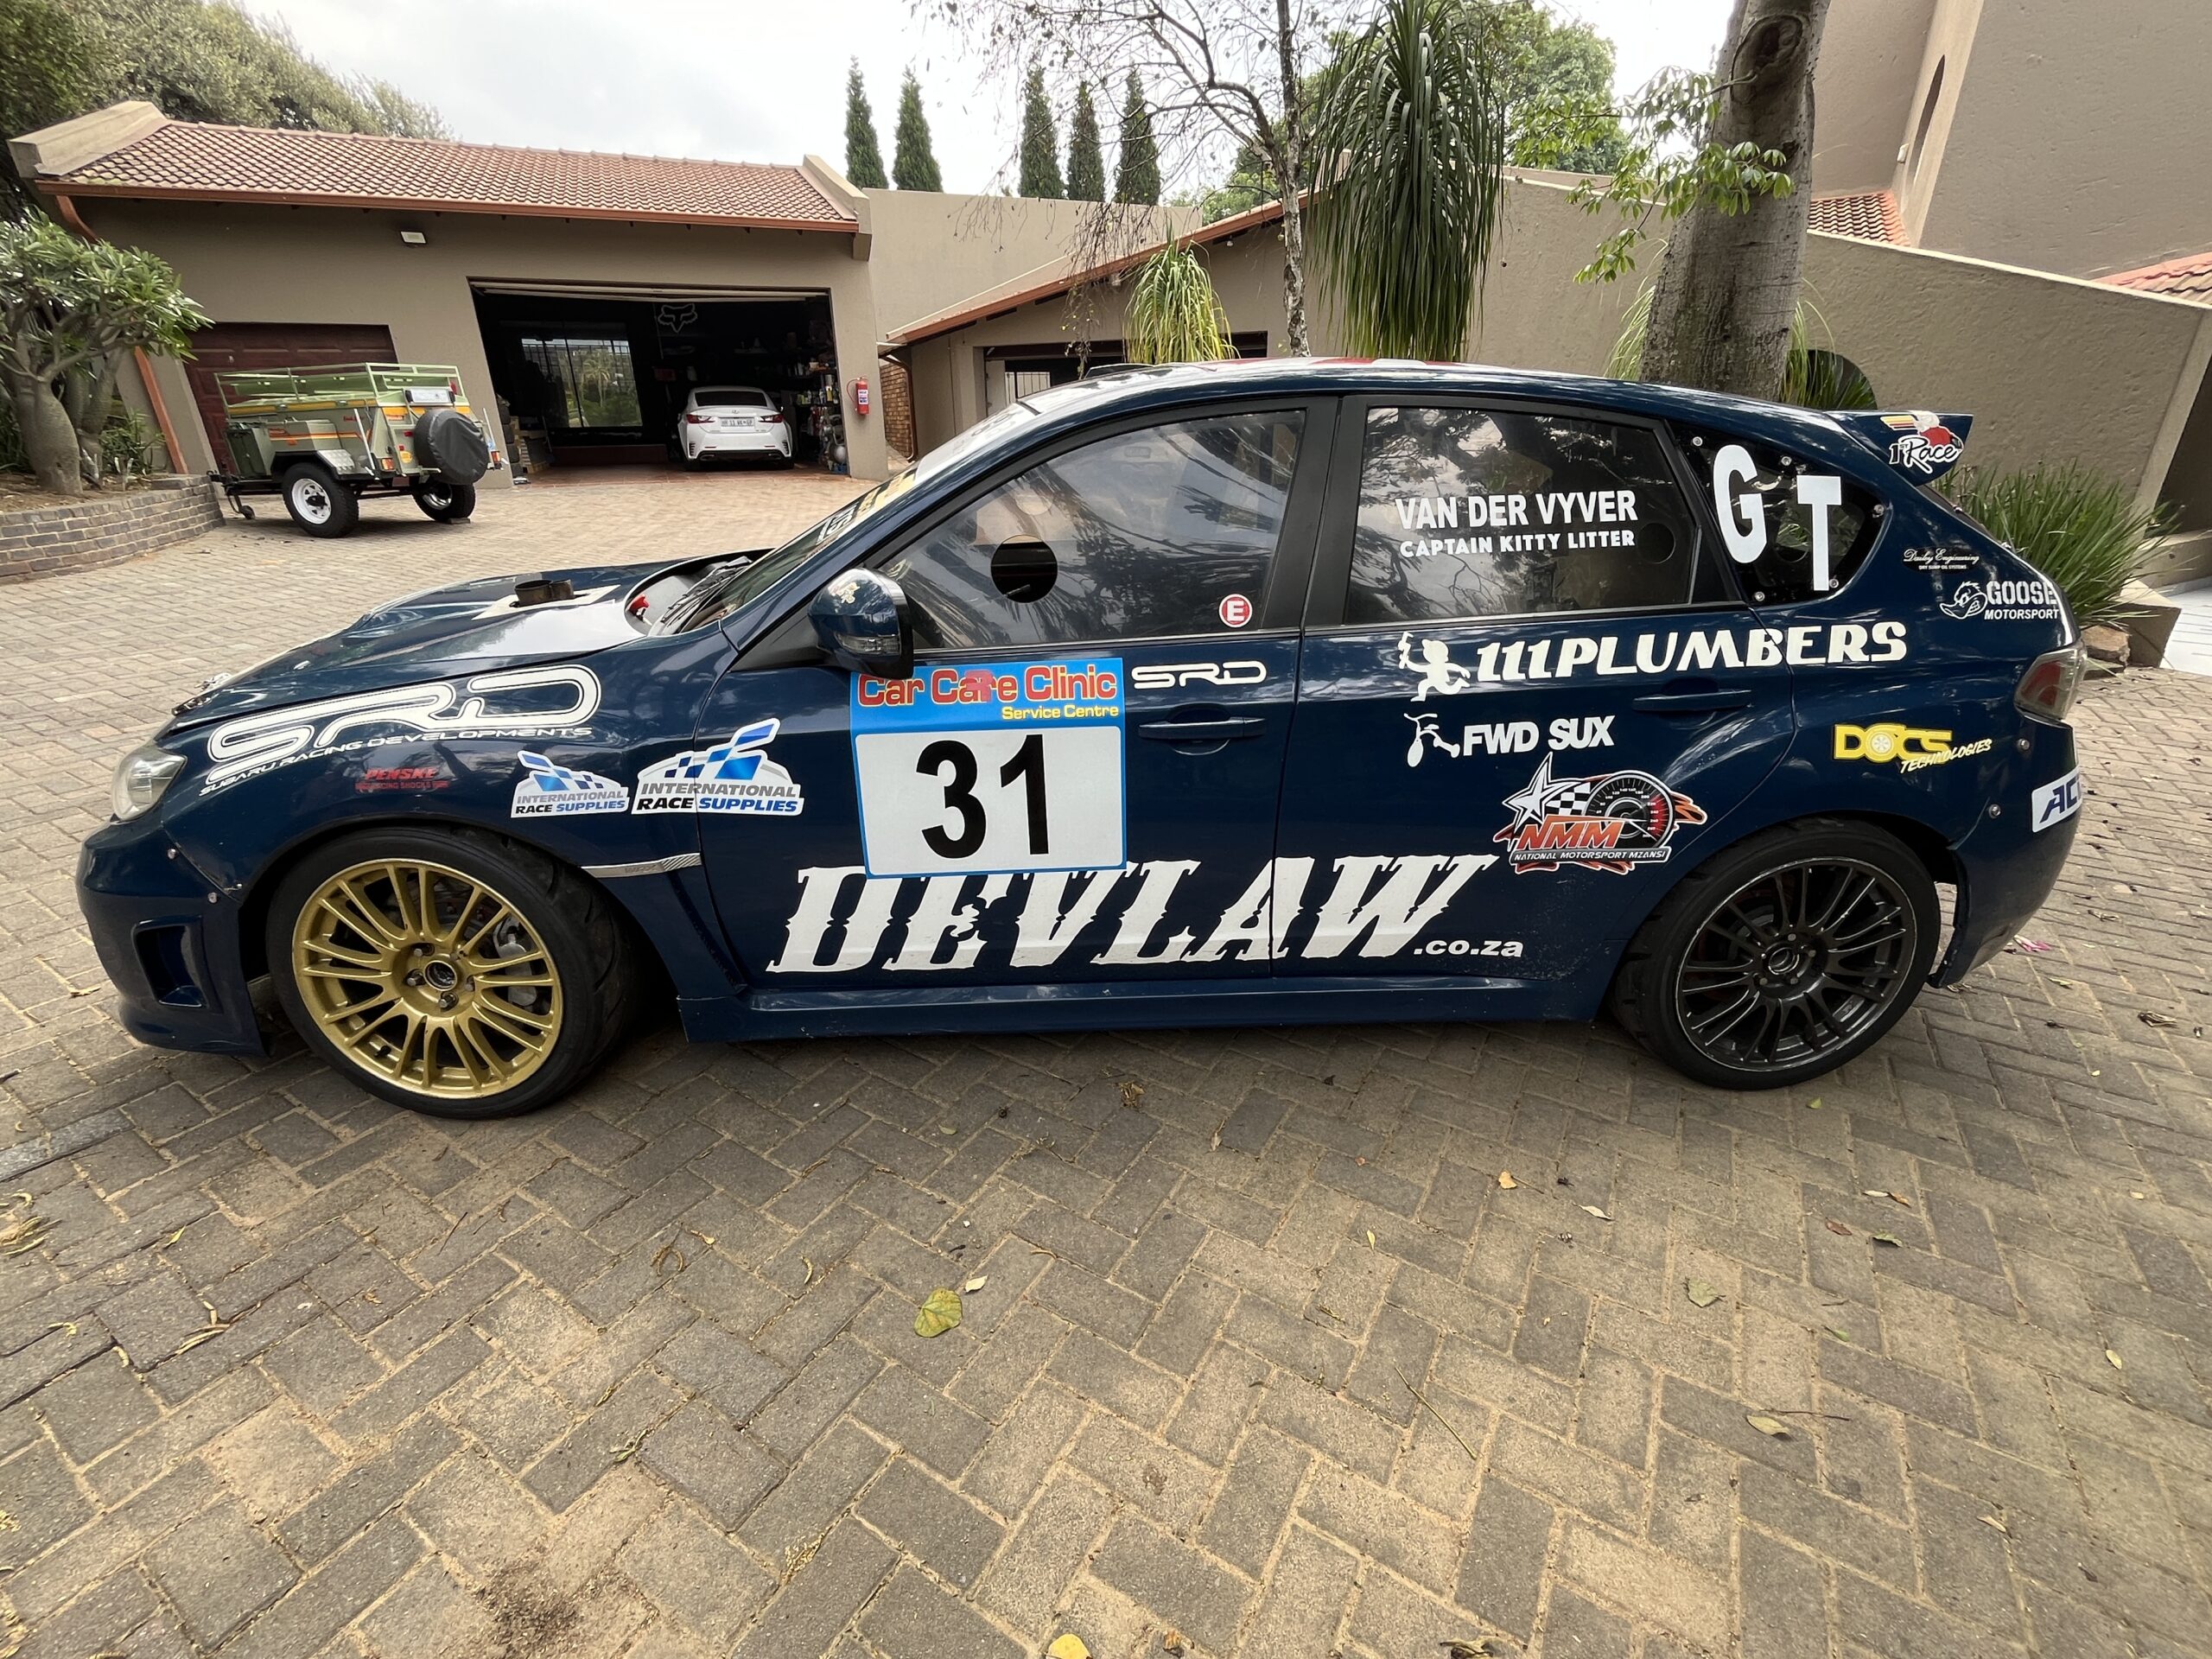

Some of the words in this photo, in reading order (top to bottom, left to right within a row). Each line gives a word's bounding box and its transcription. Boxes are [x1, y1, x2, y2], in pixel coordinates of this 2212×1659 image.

[1899, 435, 1958, 474] Race
[1395, 497, 1459, 530] VAN
[1468, 494, 1529, 528] DER
[1535, 489, 1639, 524] VYVER
[1713, 444, 1767, 563] G
[1400, 537, 1493, 558] CAPTAIN
[1500, 533, 1561, 552] KITTY
[1567, 530, 1636, 549] LITTER
[1796, 475, 1841, 590] T
[1986, 581, 2058, 605] GOOSE
[1227, 601, 1244, 622] E
[1985, 608, 2059, 620] MOTORSPORT
[858, 674, 924, 707] Car
[931, 669, 1019, 705] Care
[1025, 664, 1118, 702] Clinic
[1132, 661, 1267, 690] SRD
[206, 664, 602, 785] SRD
[1001, 706, 1061, 720] Service
[1064, 705, 1119, 717] Centre
[1463, 721, 1539, 756] FWD
[1548, 715, 1615, 749] SUX
[1834, 724, 1953, 763] DOCS
[199, 761, 276, 797] SUBARU
[279, 741, 362, 767] RACING
[366, 728, 593, 748] DEVELOPMENTS
[1900, 738, 1993, 774] TECHNOLOGIES
[365, 766, 437, 779] PENSKE
[517, 791, 624, 804] INTERNATIONAL
[637, 797, 695, 811] RACE
[698, 797, 798, 812] SUPPLIES
[641, 783, 797, 798] INTERNATIONAL
[916, 734, 1049, 859] 31
[2039, 772, 2081, 824] AC
[516, 804, 553, 814] RACE
[556, 800, 626, 812] SUPPLIES
[1516, 821, 1625, 850] NMM
[1514, 853, 1557, 861] NATIONAL
[1560, 850, 1625, 860] MOTORSPORT
[1628, 849, 1667, 859] MZANSI
[766, 854, 1500, 973] DEVLAW
[1414, 939, 1524, 958] .co.za
